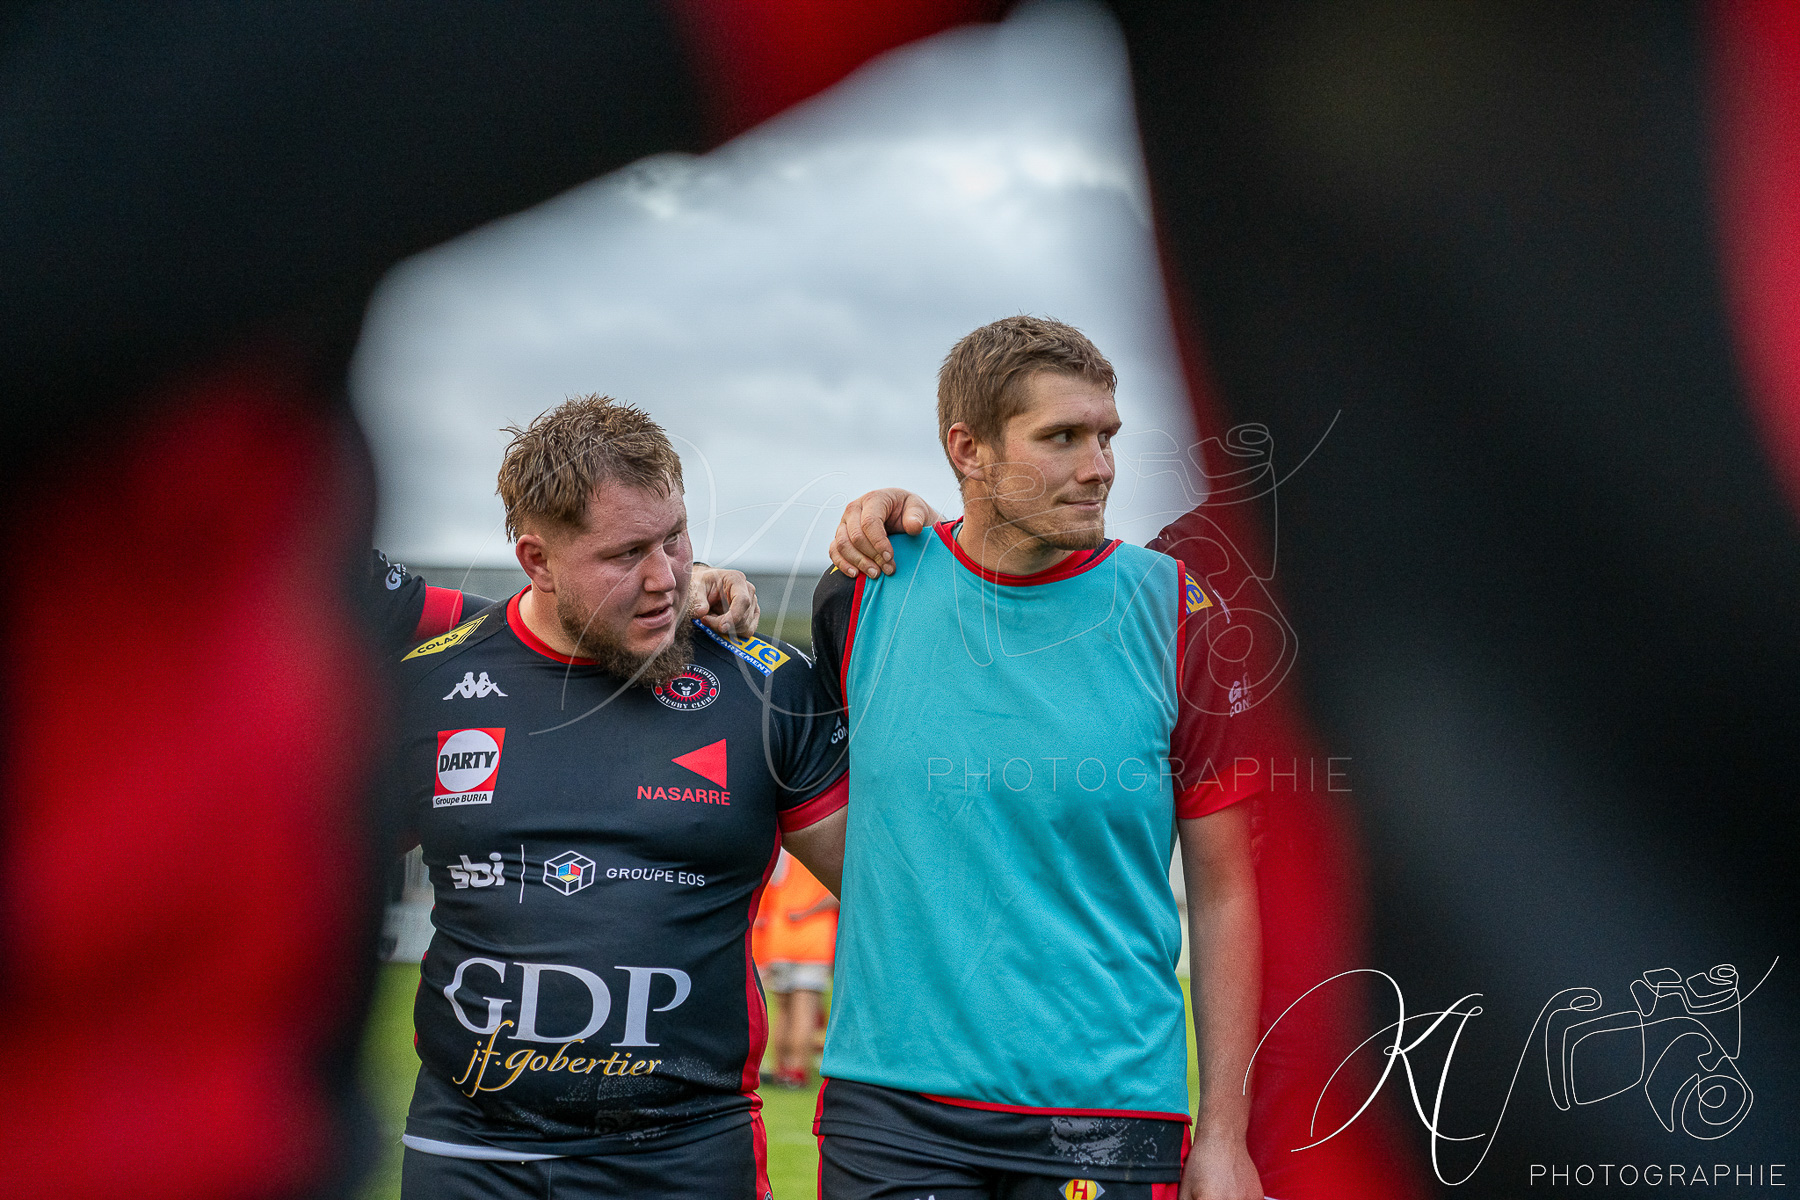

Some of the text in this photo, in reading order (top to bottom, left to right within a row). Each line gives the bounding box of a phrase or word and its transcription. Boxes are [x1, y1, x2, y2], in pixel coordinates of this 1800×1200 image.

[417, 633, 459, 653] COLAS
[660, 695, 712, 709] RUGBY CLUB
[439, 750, 498, 773] DARTY
[435, 793, 488, 806] Groupe BURIA
[636, 785, 731, 806] NASARRE
[606, 867, 706, 887] GROUPE EOS
[443, 956, 693, 1047] GDP
